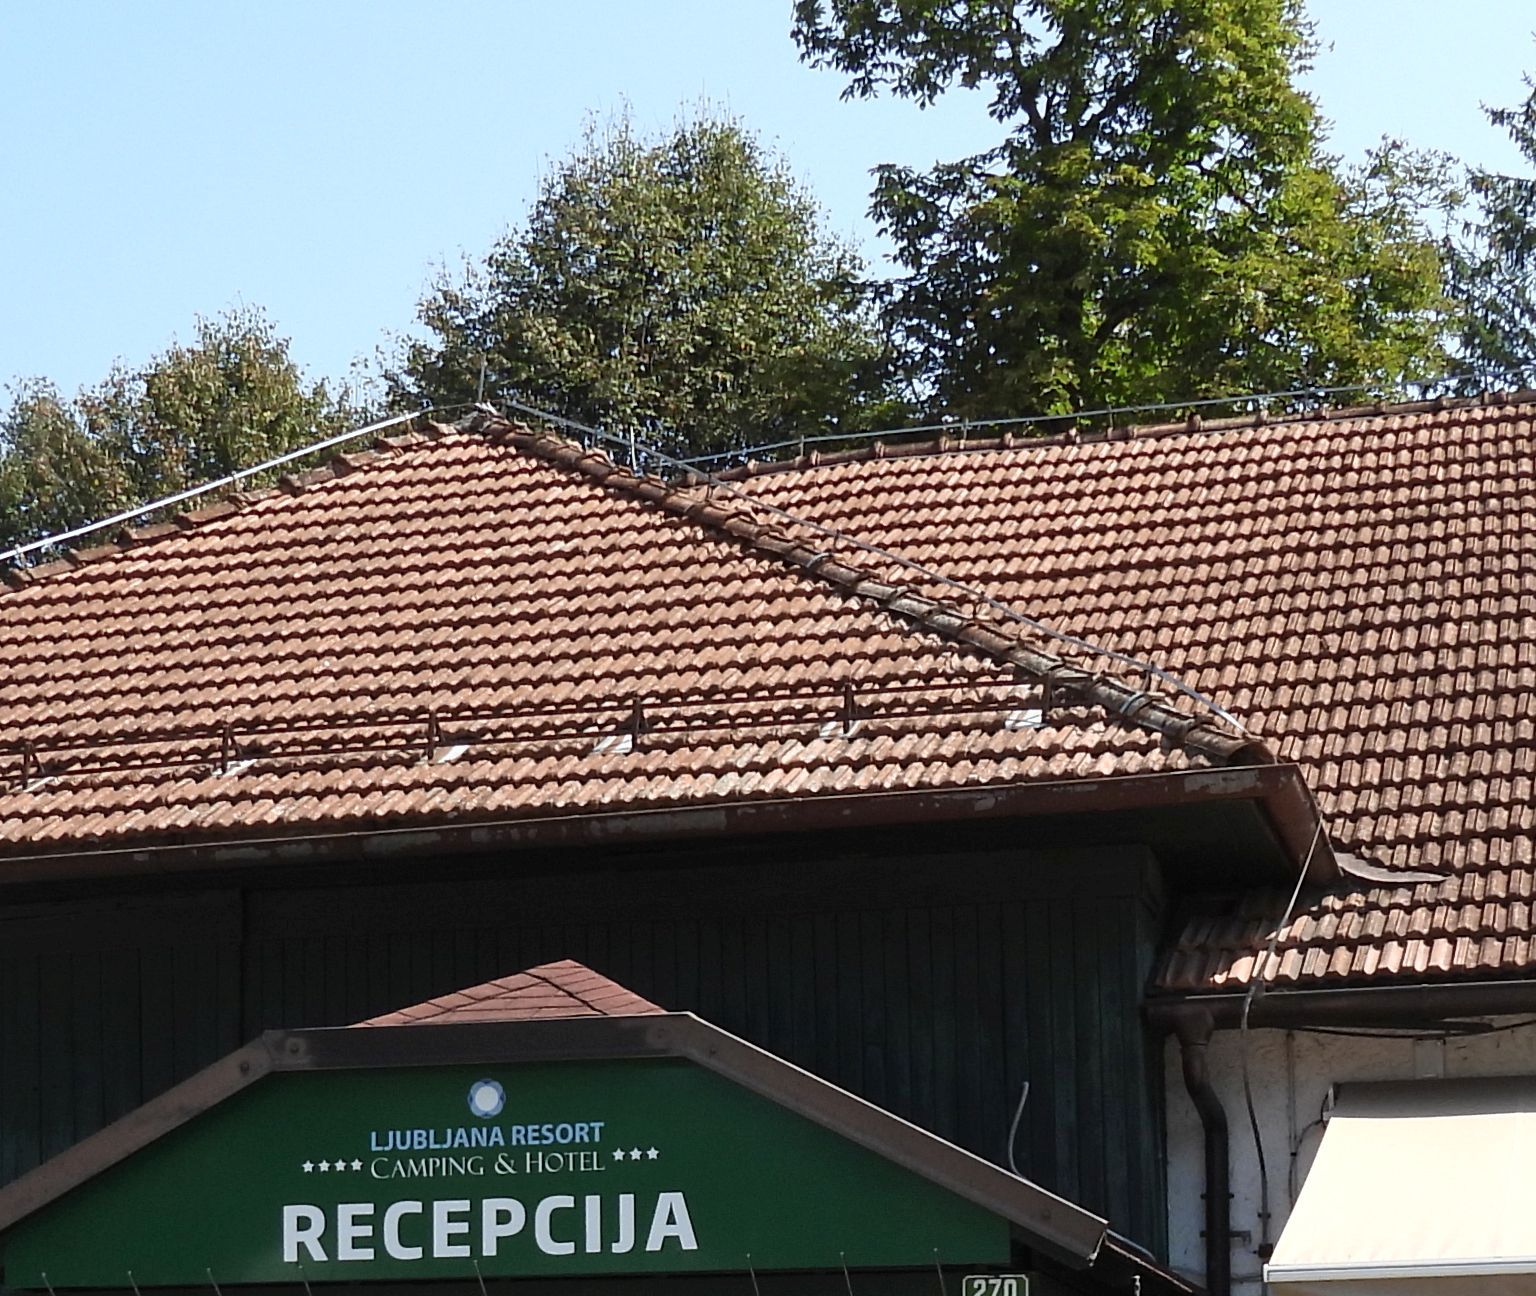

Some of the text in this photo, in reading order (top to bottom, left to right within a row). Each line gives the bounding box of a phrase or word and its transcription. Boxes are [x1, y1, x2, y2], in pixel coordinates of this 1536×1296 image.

[370, 1122, 605, 1152] LJUBLJANA RESORT
[370, 1150, 606, 1180] CAMPING & HOTEL
[282, 1191, 699, 1263] RECEPCIJA
